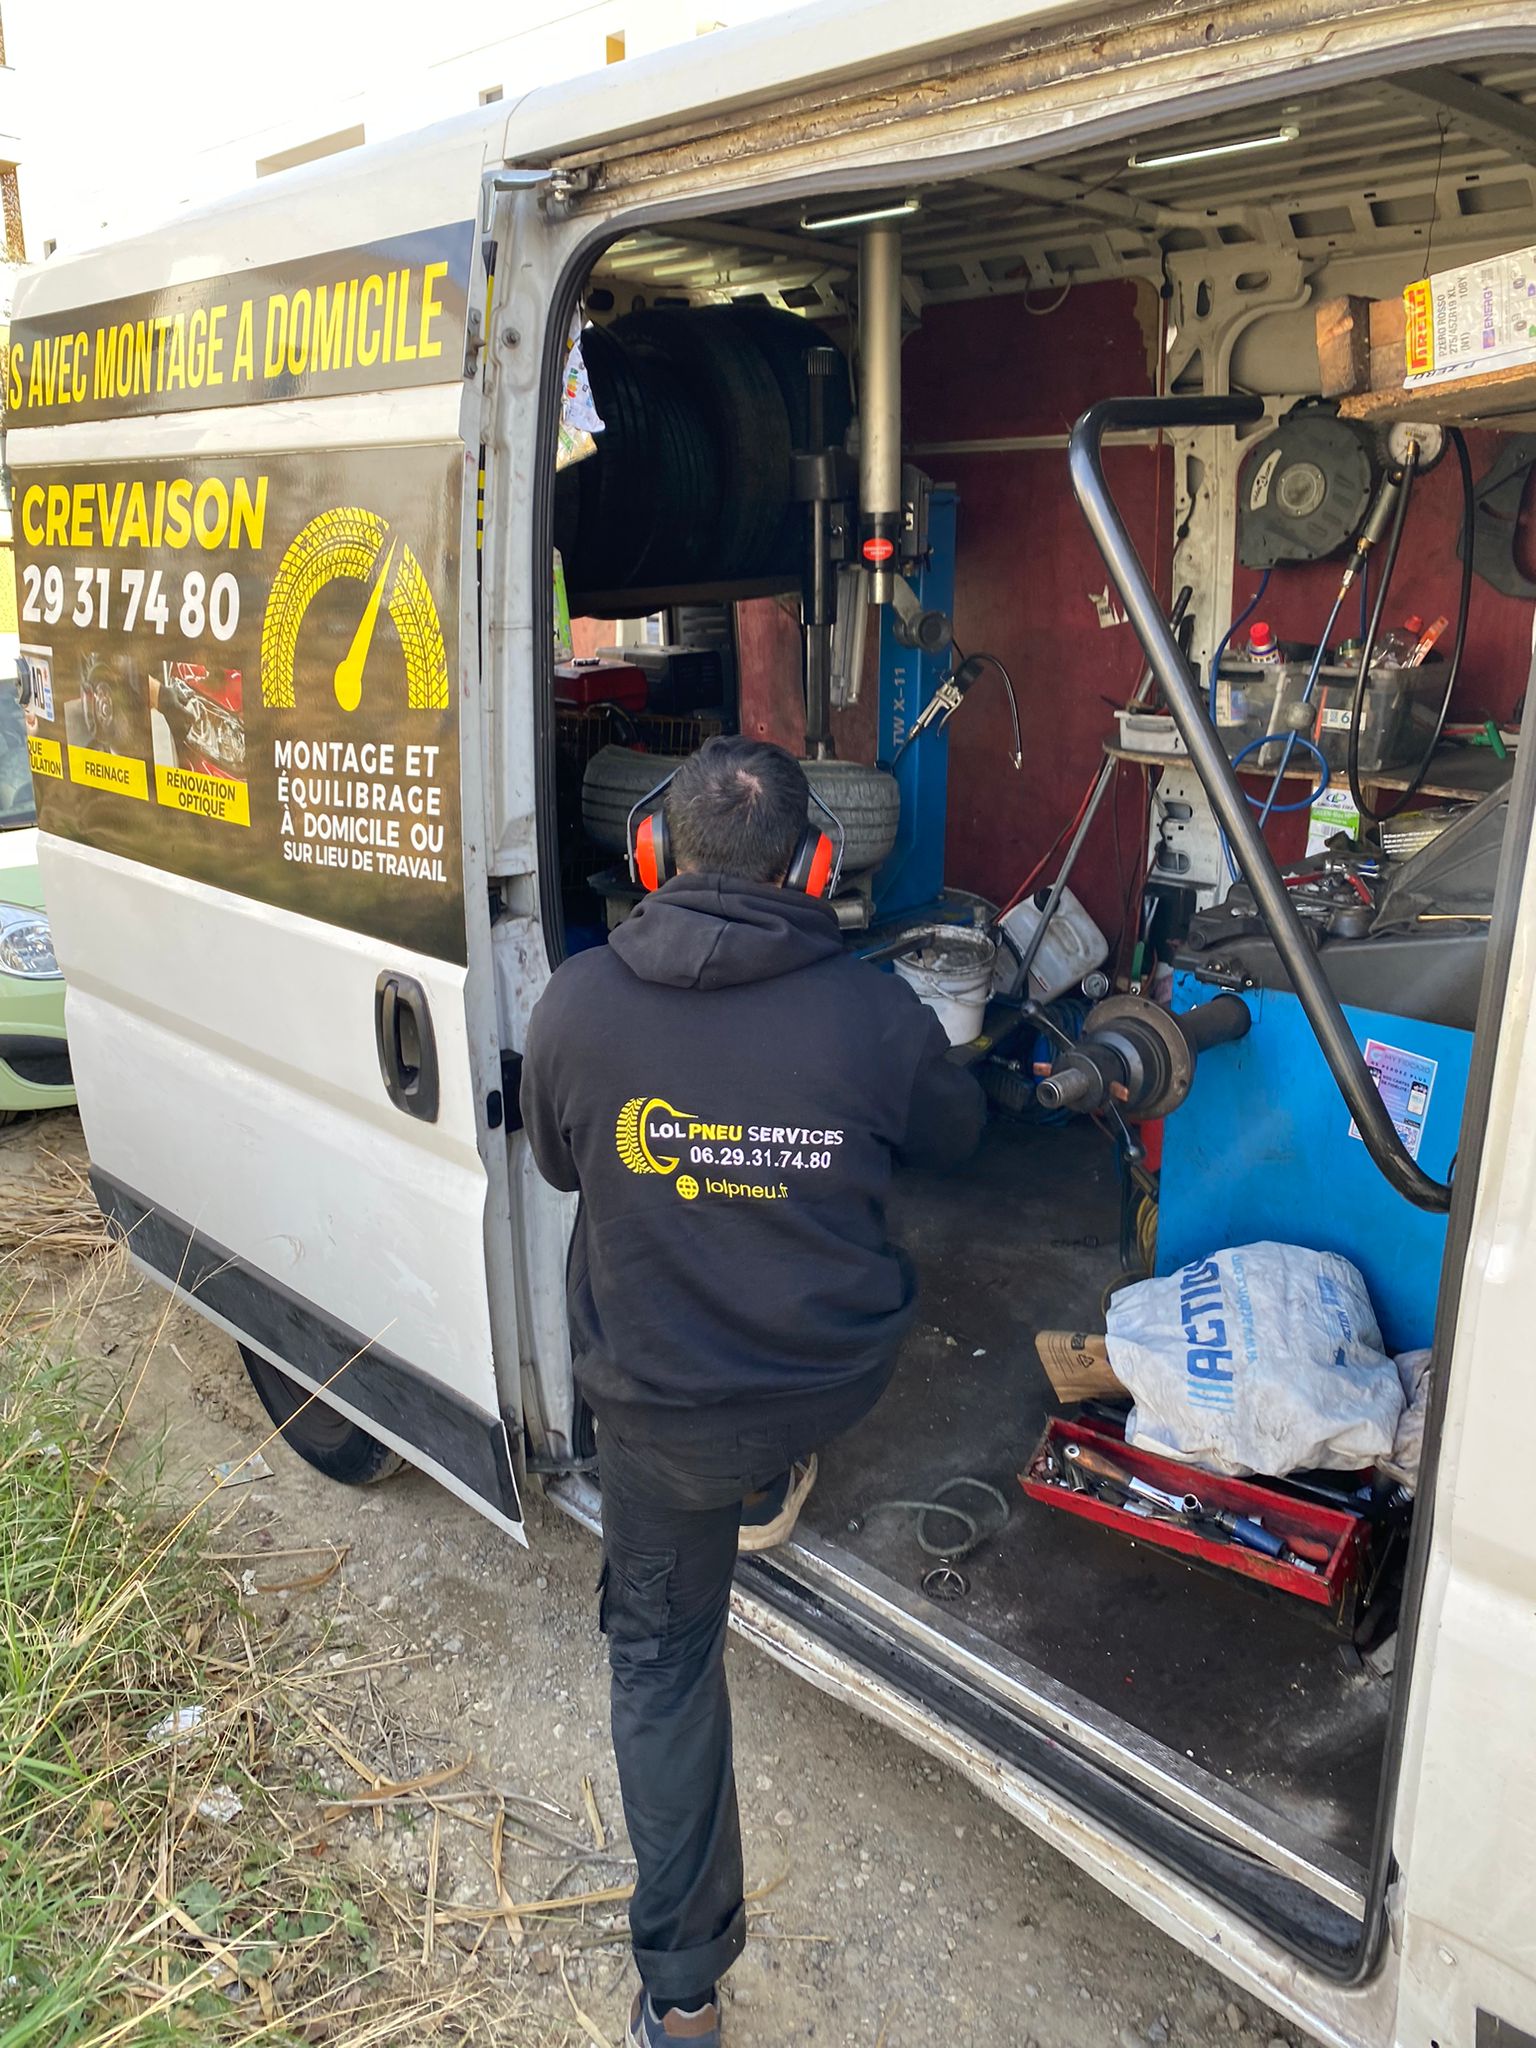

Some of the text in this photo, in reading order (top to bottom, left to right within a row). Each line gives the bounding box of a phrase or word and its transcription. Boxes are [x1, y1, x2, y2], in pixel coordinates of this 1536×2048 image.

[1448, 286, 1456, 298] XL
[1458, 275, 1468, 299] 108Y
[1437, 294, 1446, 324] ROSSO
[7, 261, 448, 410] S AVEC MONTAGE A DOMICILE
[1408, 288, 1428, 368] PIRELLI
[22, 476, 269, 549] CREVAISON
[22, 564, 240, 642] 29 31 74 80
[84, 760, 130, 785] FREINAGE
[274, 740, 439, 778] MONTAGE ET
[166, 769, 236, 802] RÉNOVATION
[277, 770, 441, 816] ÉQUILIBRAGE
[178, 792, 226, 818] OPTIQUE
[280, 803, 444, 853] À DOMICILE OU
[283, 841, 447, 882] SUR LIEU DE TRAVAIL
[650, 1122, 844, 1146] LOL PNEU SERVICES
[690, 1145, 831, 1169] 06.29.31.74.80
[705, 1177, 789, 1199] lolpneu.fr
